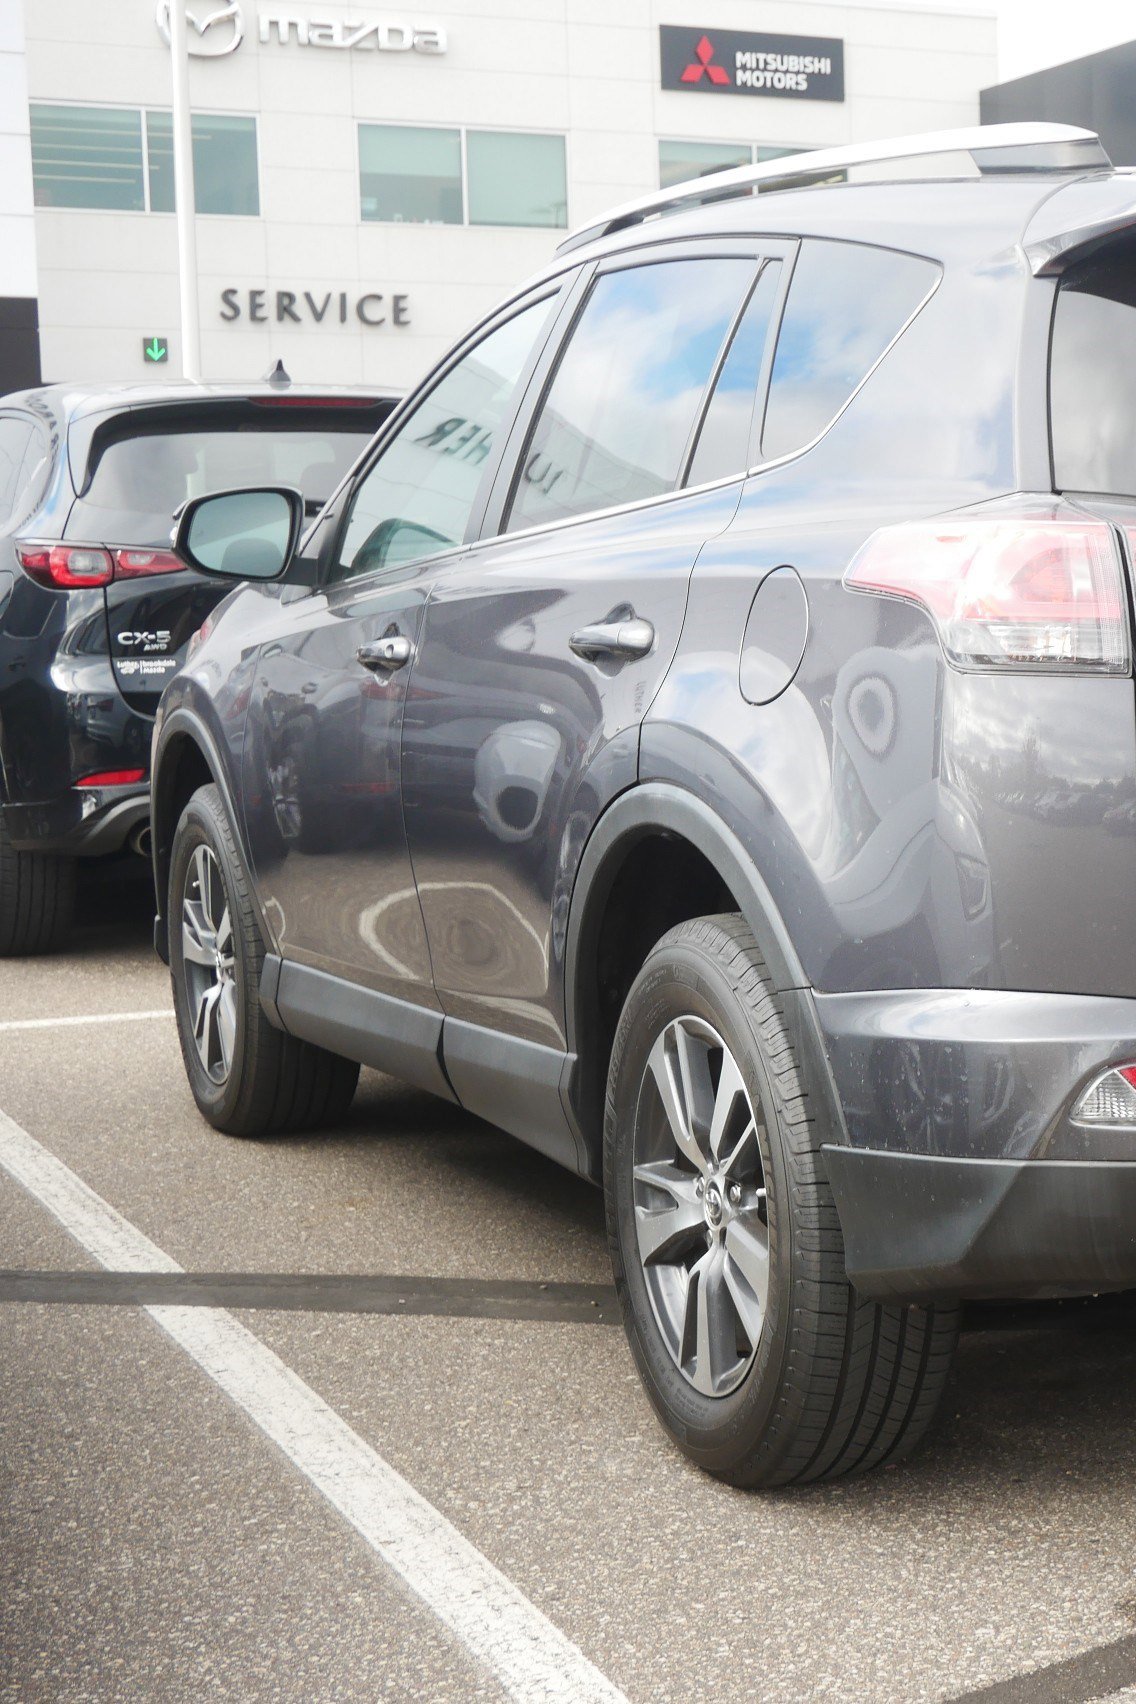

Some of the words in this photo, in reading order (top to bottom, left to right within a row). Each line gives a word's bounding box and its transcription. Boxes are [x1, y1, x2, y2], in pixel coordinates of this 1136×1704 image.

[735, 51, 831, 75] MITSUBISHI
[735, 69, 808, 91] MOTORS
[219, 288, 411, 326] SERVICE
[117, 630, 171, 645] CX-5
[143, 643, 168, 651] AWD
